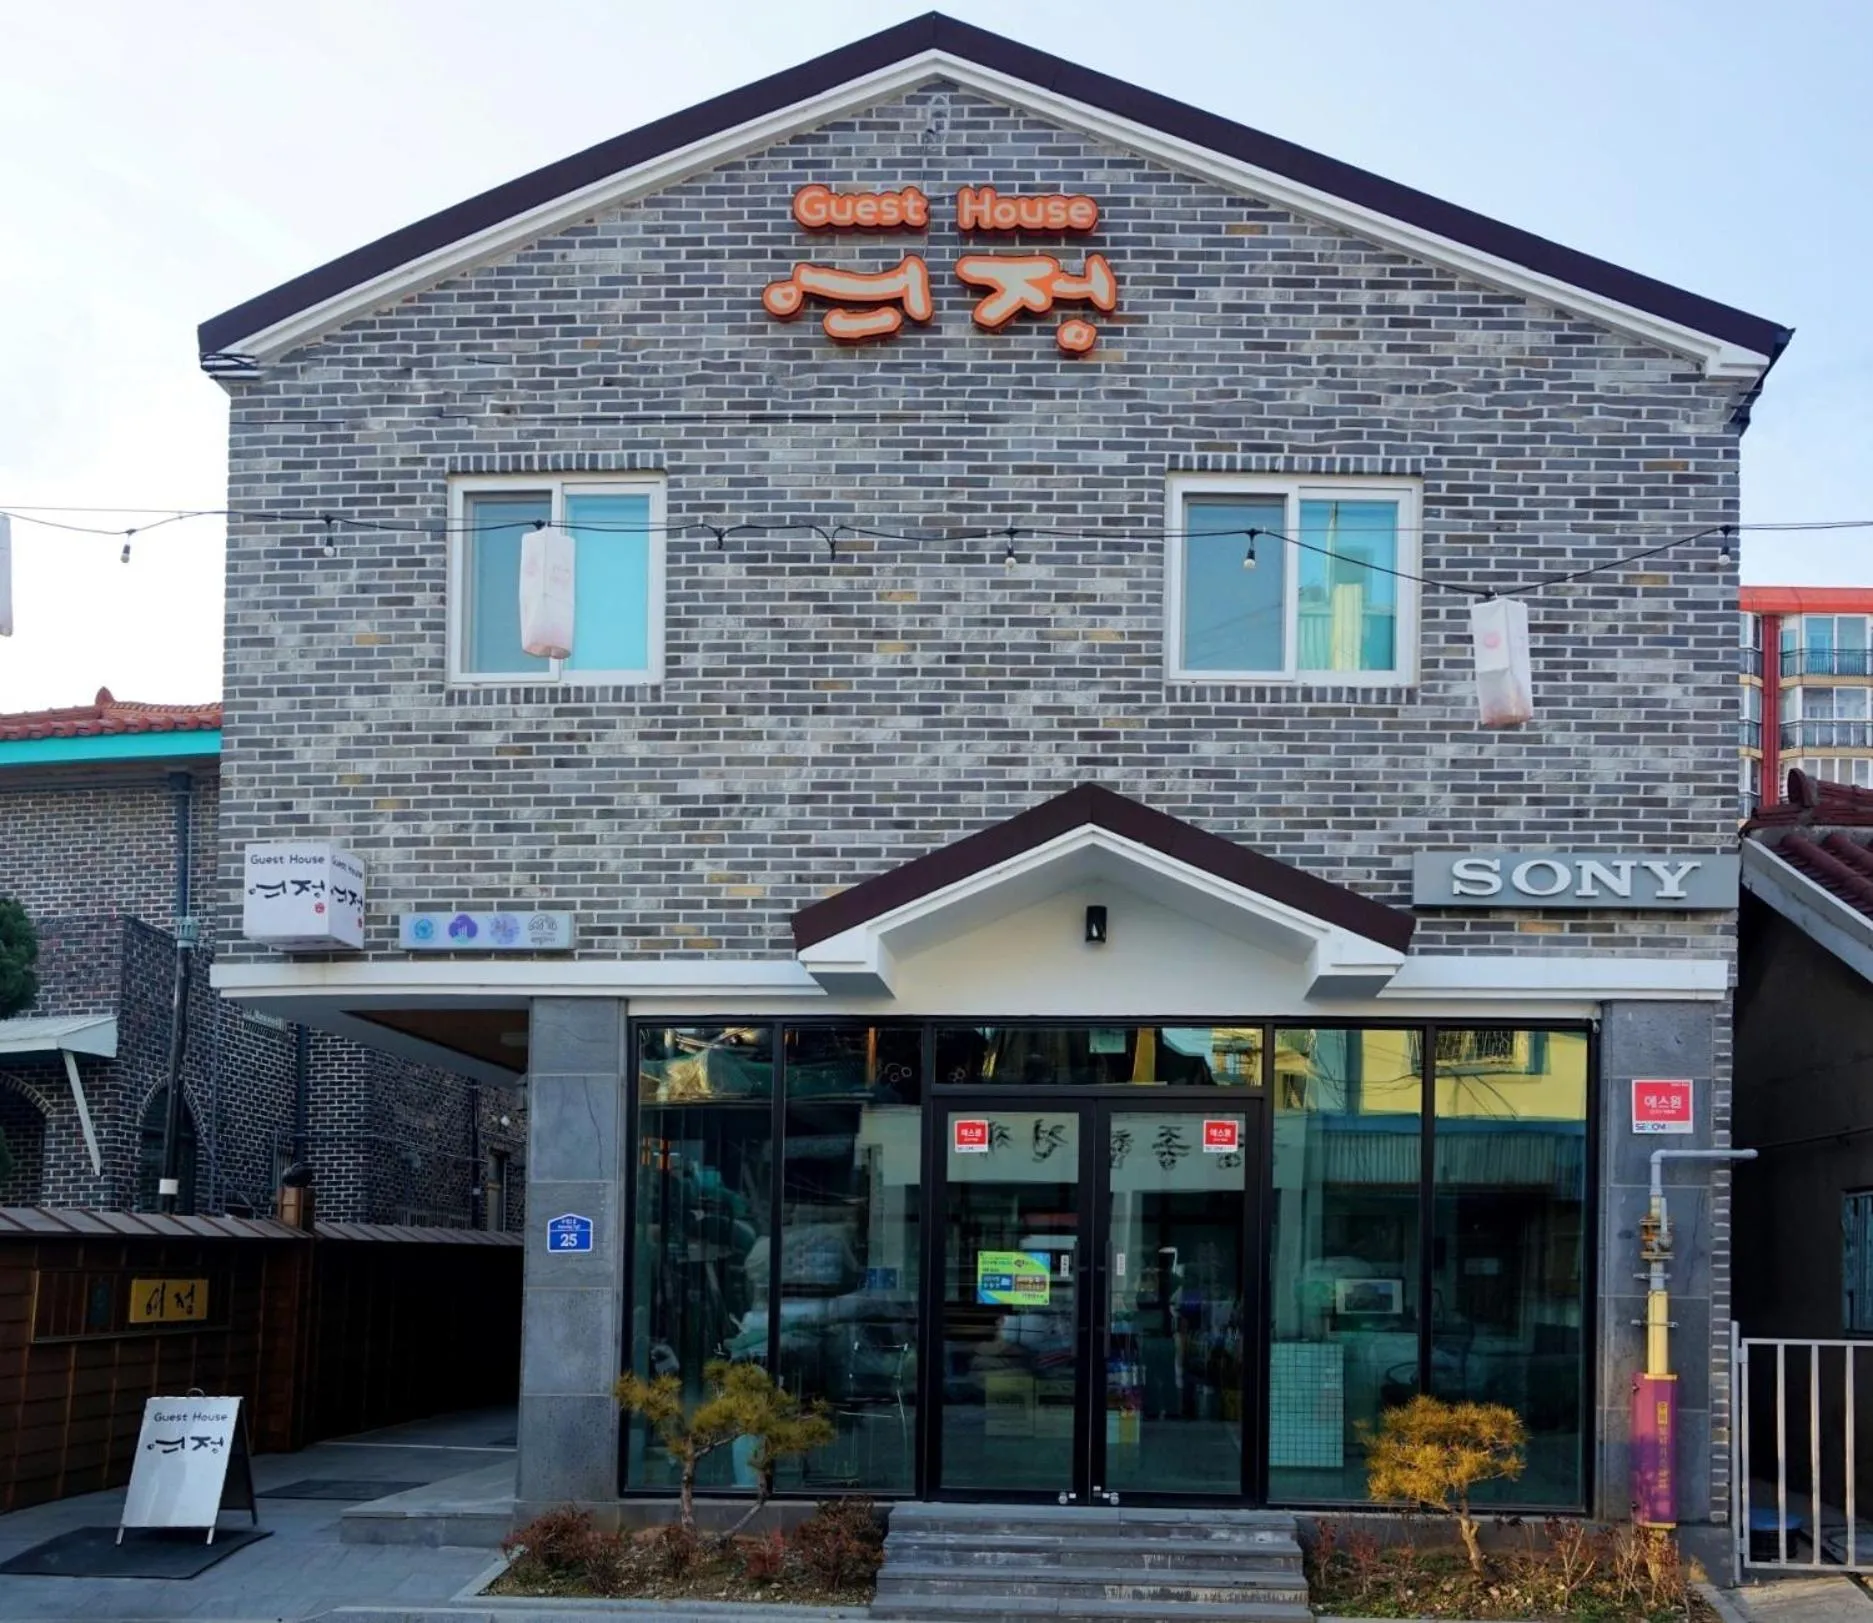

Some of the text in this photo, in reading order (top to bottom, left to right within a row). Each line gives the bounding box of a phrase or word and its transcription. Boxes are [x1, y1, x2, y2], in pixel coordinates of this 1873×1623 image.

[795, 187, 1096, 229] Guest House
[250, 854, 325, 865] Guest House
[1452, 858, 1702, 899] SONY
[1643, 1095, 1683, 1110] 에스원
[560, 1233, 578, 1247] 25
[153, 1412, 229, 1422] Guest House
